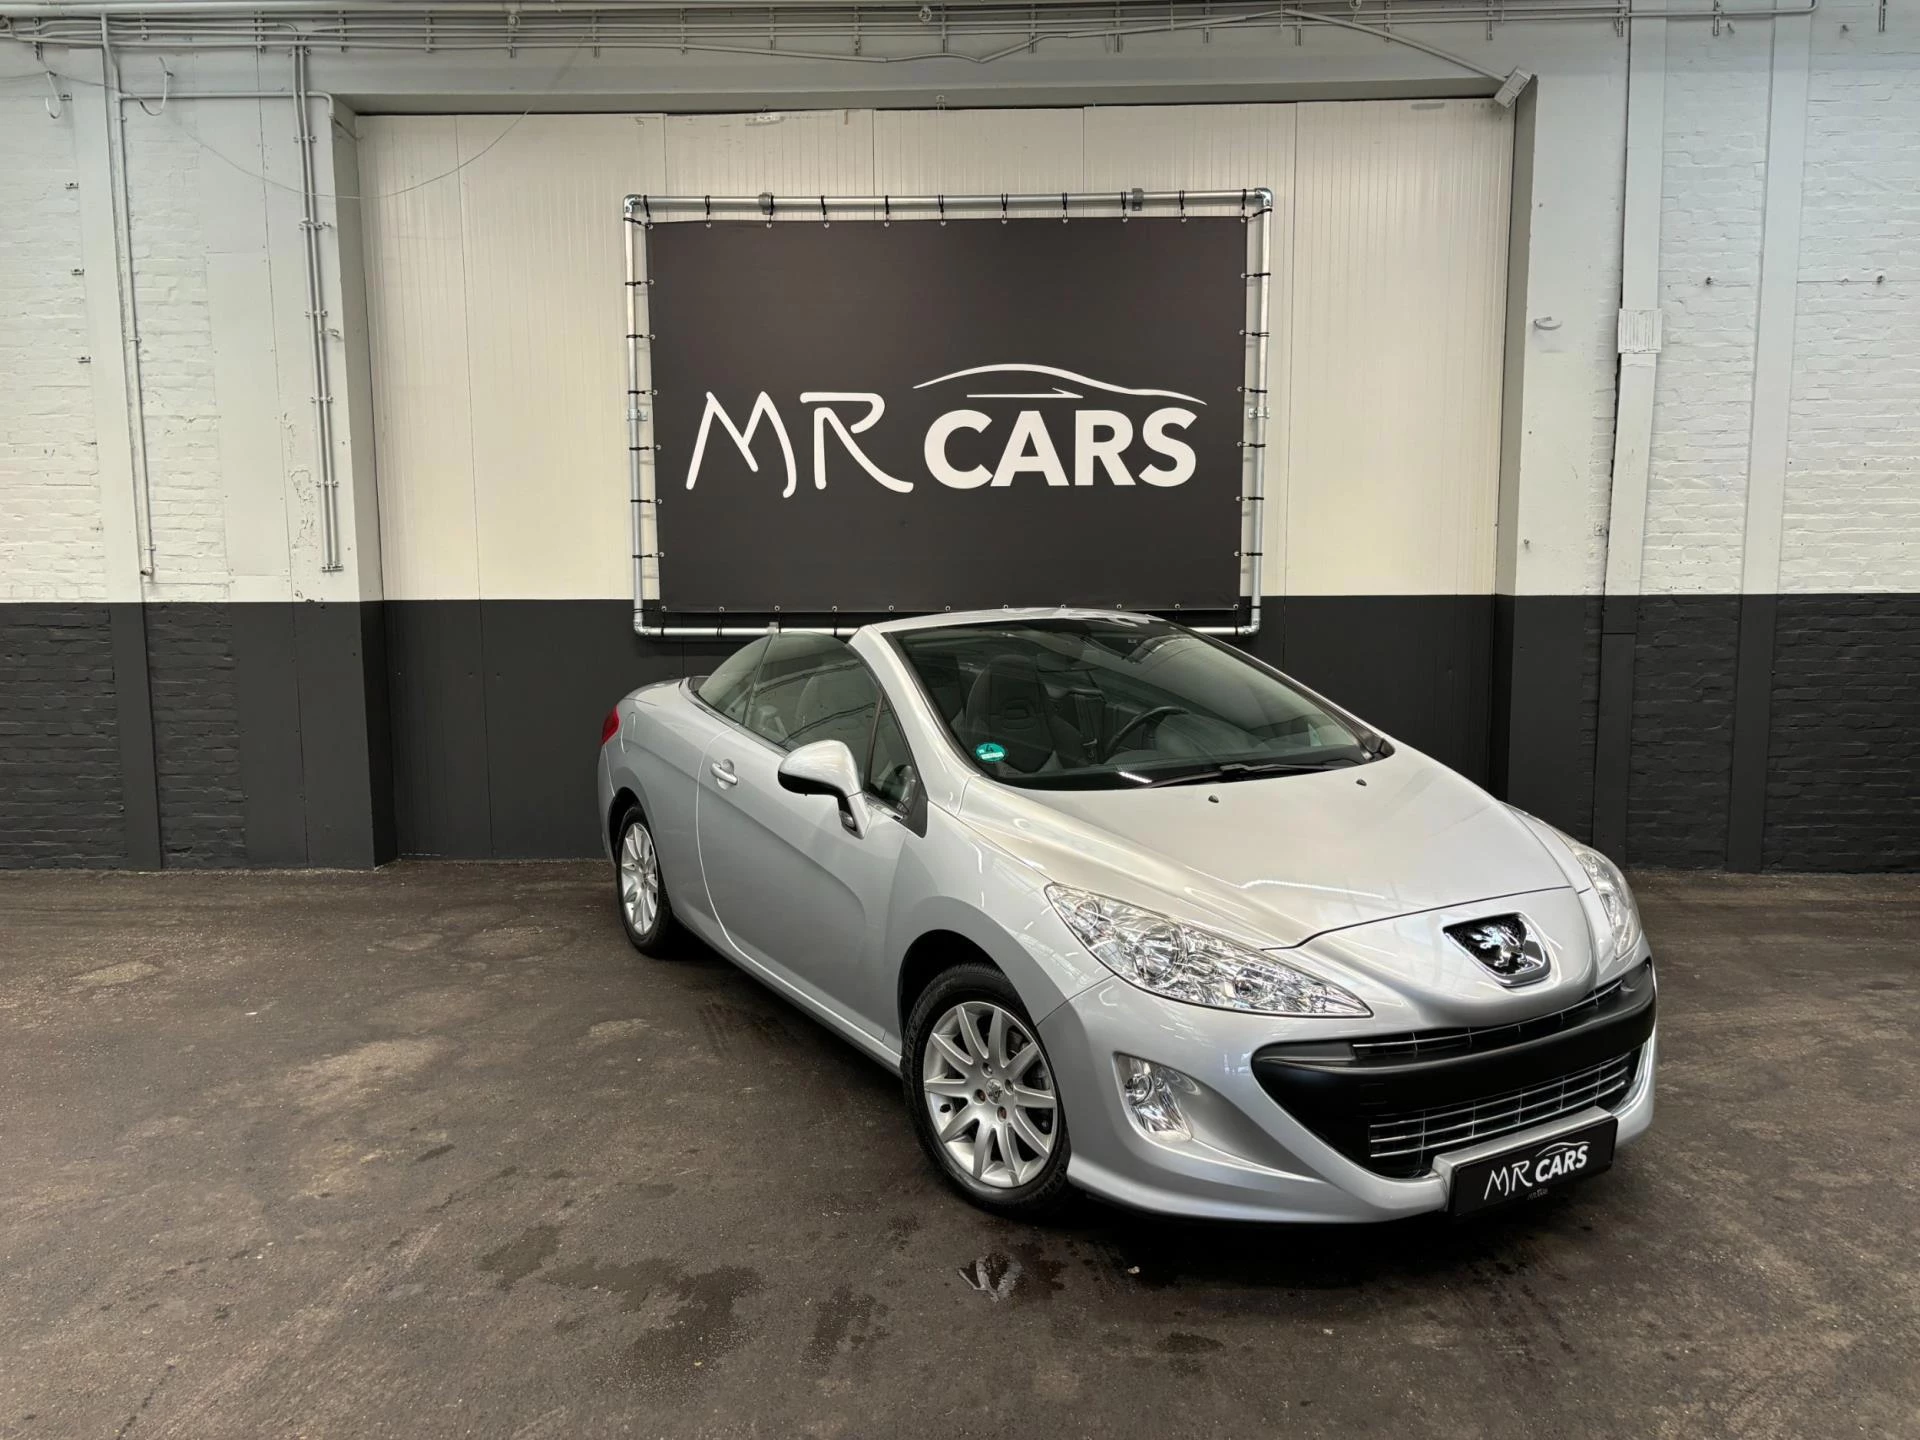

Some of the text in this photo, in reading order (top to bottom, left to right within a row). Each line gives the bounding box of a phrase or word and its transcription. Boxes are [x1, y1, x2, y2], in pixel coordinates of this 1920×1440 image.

[685, 390, 1198, 499] MR CARS
[1483, 1145, 1589, 1200] MR CARS
